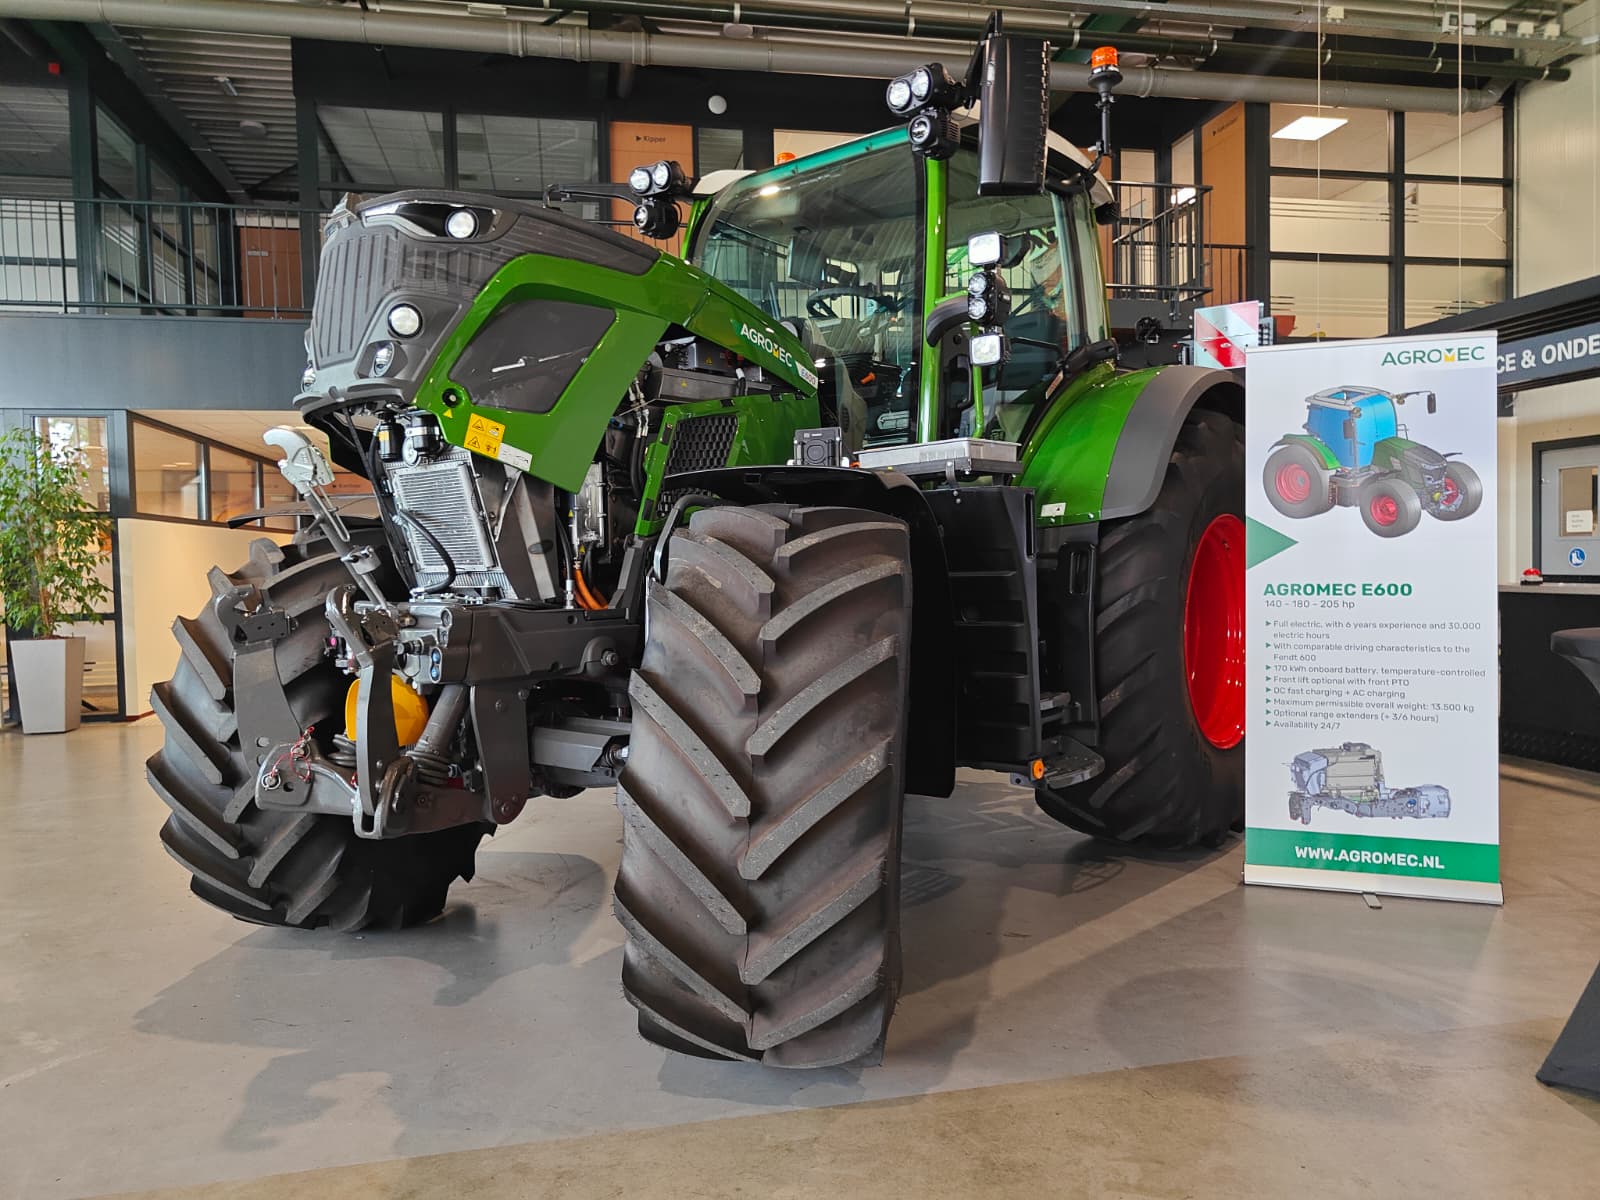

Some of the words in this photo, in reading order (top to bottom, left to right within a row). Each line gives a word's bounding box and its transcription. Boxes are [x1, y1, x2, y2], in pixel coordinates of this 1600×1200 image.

[1381, 346, 1485, 366] AGROMEC
[1521, 349, 1536, 369] &
[1541, 334, 1600, 365] ONDE
[1263, 583, 1357, 596] AGROMEC
[1361, 583, 1413, 596] E600
[1265, 600, 1282, 608] 140
[1292, 600, 1310, 608] 180
[1320, 600, 1340, 608] 205
[1342, 600, 1355, 610] hp
[1273, 620, 1288, 628] Full
[1325, 620, 1344, 629] with
[1346, 621, 1352, 629] 6
[1353, 622, 1377, 630] years
[1379, 621, 1427, 630] experience
[1429, 622, 1446, 630] and
[1273, 631, 1304, 639] electric
[1306, 632, 1330, 640] hours
[1273, 642, 1292, 650] With
[1293, 642, 1343, 652] comparable
[1344, 643, 1374, 653] driving
[1375, 644, 1442, 653] characteristics
[1443, 645, 1453, 653] to
[1455, 645, 1470, 653] the
[1273, 653, 1298, 661] Fendt
[1300, 654, 1317, 662] 600
[1274, 664, 1288, 672] 170
[1289, 664, 1306, 672] kWh
[1308, 665, 1343, 673] onboard
[1381, 667, 1486, 678] temperature-controlled
[1273, 675, 1296, 684] Front
[1298, 675, 1310, 684] lift
[1311, 676, 1345, 685] optional
[1347, 677, 1366, 685] with
[1368, 677, 1389, 686] front
[1391, 678, 1410, 687] PTO
[1273, 687, 1286, 695] DC
[1288, 687, 1304, 695] fast
[1305, 687, 1343, 697] charging
[1352, 689, 1366, 697] AC
[1367, 690, 1406, 699] charging
[1273, 698, 1313, 706] Maximum
[1315, 699, 1364, 708] permissible
[1365, 701, 1395, 709] overall
[1396, 702, 1429, 711] weight:
[1431, 703, 1461, 712] 13.500
[1463, 704, 1474, 713] kg
[1273, 709, 1308, 718] Optional
[1310, 711, 1334, 719] range
[1335, 711, 1379, 720] extenders
[1380, 712, 1390, 721] (+
[1392, 713, 1408, 721] 3/6
[1410, 713, 1439, 723] hours)
[1273, 720, 1319, 729] Availability
[1320, 722, 1341, 730] 24/7
[1295, 846, 1445, 869] WWW.AGROMEC.NL
